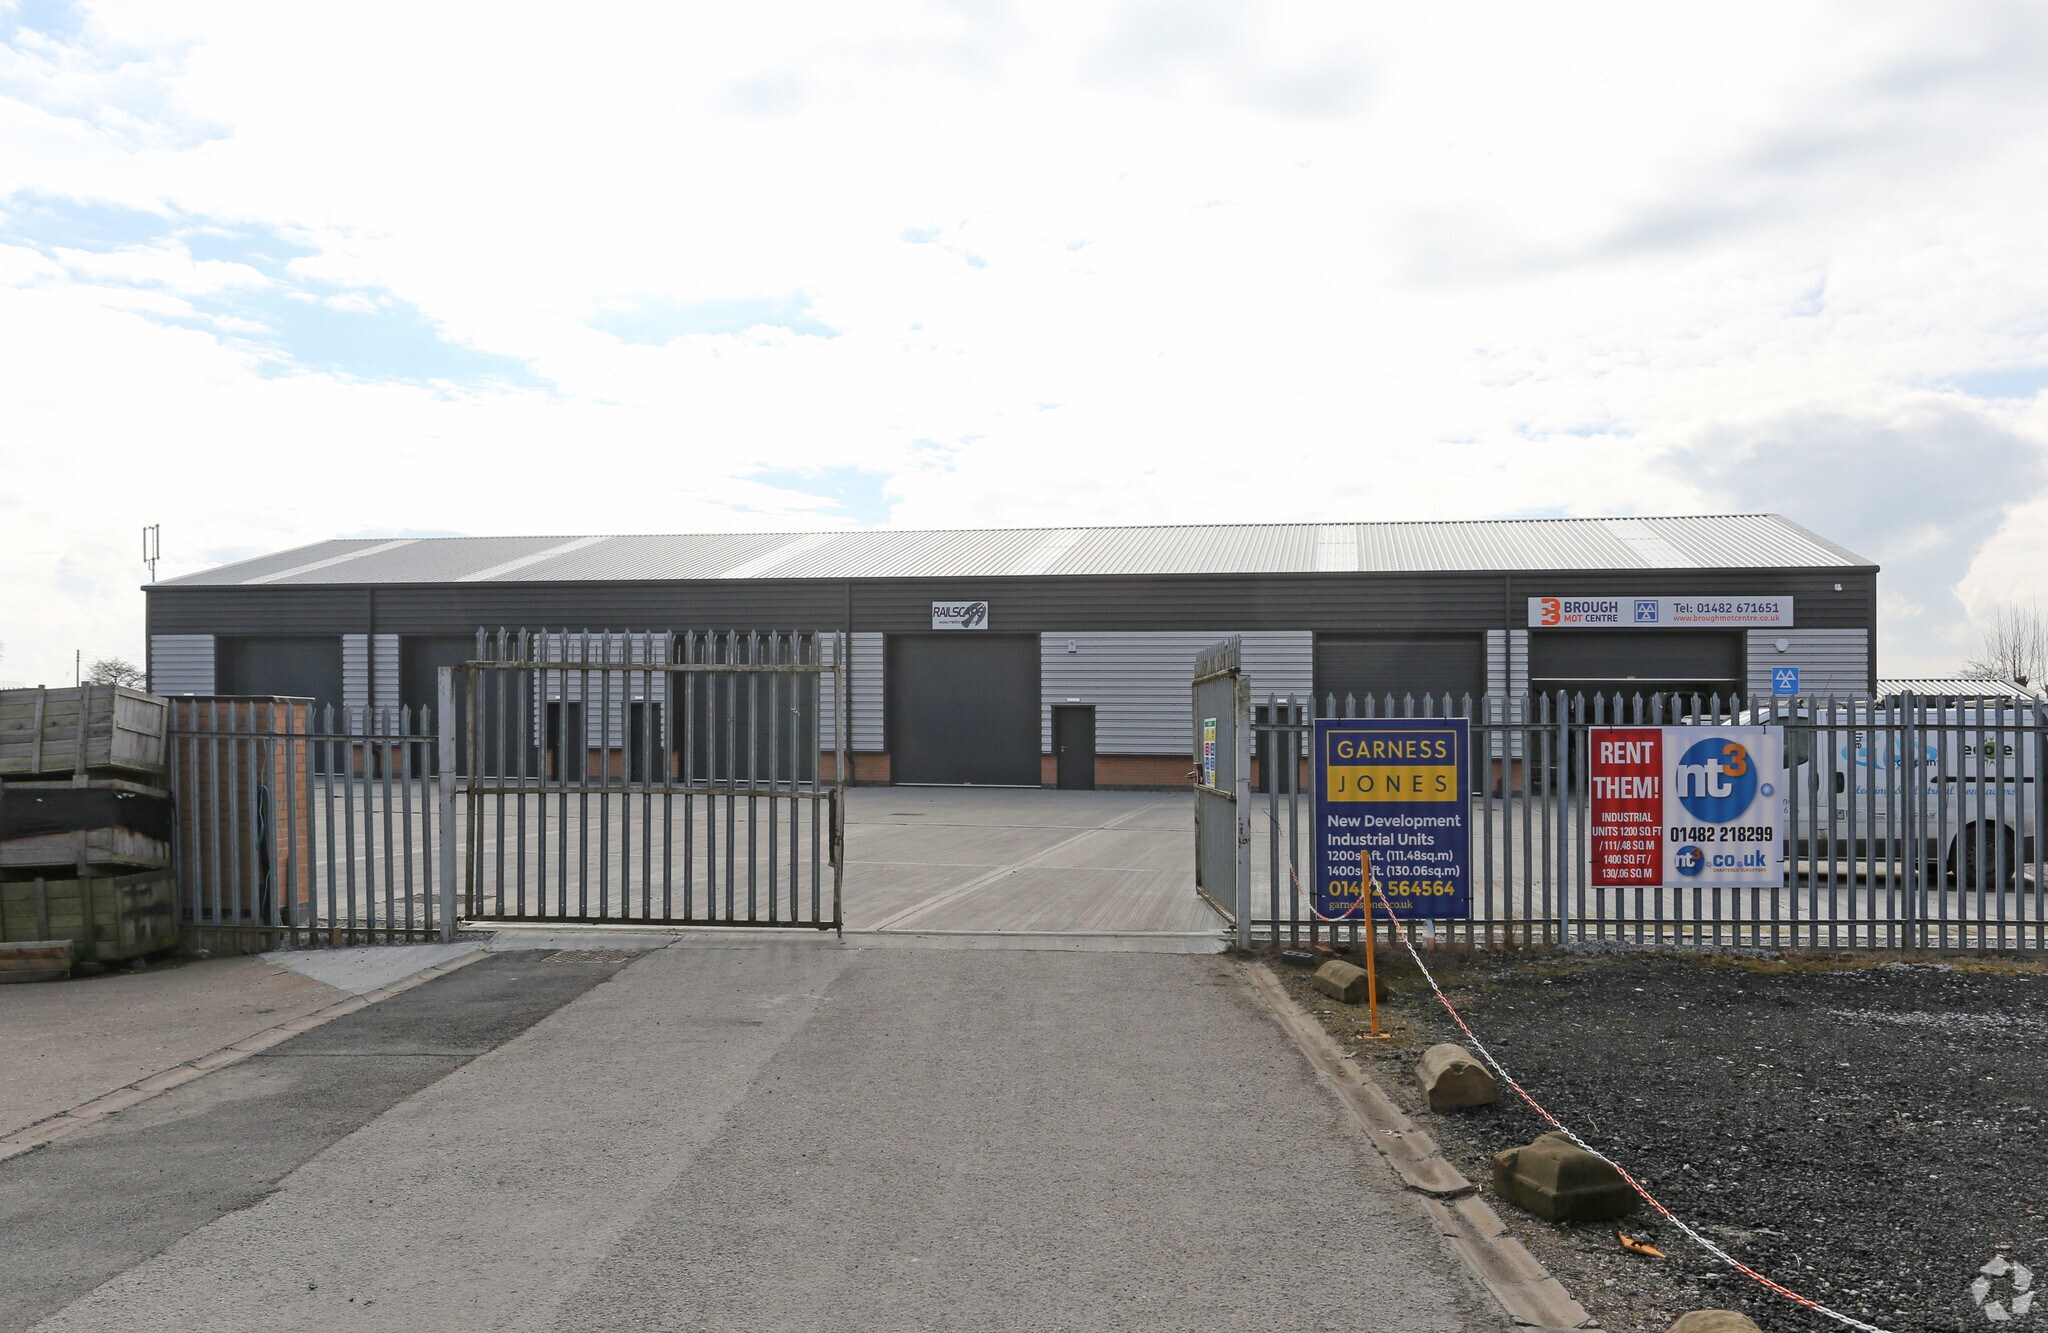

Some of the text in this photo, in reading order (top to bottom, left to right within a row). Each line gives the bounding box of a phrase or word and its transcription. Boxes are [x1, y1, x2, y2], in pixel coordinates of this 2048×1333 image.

[1564, 601, 1618, 613] BROUGH
[1673, 602, 1779, 613] Tel: 01482 671651
[1564, 614, 1618, 622] MOT CENTRE
[1673, 614, 1780, 623] www.broughmotcentre.co.uk
[1337, 740, 1447, 759] GARNESS
[1600, 741, 1654, 764] RENT
[1338, 775, 1447, 792] JONES
[1593, 776, 1659, 799] THEM!
[1327, 814, 1461, 830] New Development
[1601, 812, 1653, 822] INDUSTRIAL
[1592, 826, 1618, 837] UNITS
[1620, 826, 1638, 837] 1200
[1652, 826, 1662, 836] FT
[1670, 826, 1773, 842] 01482 218299
[1327, 833, 1435, 846] Industrial Units
[1645, 840, 1655, 850] M
[1327, 850, 1453, 863] 1200s.ft. (111.48sq.m)
[1604, 854, 1622, 864] 1400
[1636, 854, 1646, 864] FT
[1386, 865, 1460, 878] (130.06sq.m)
[1643, 868, 1652, 878] M
[1388, 880, 1455, 897] 564564
